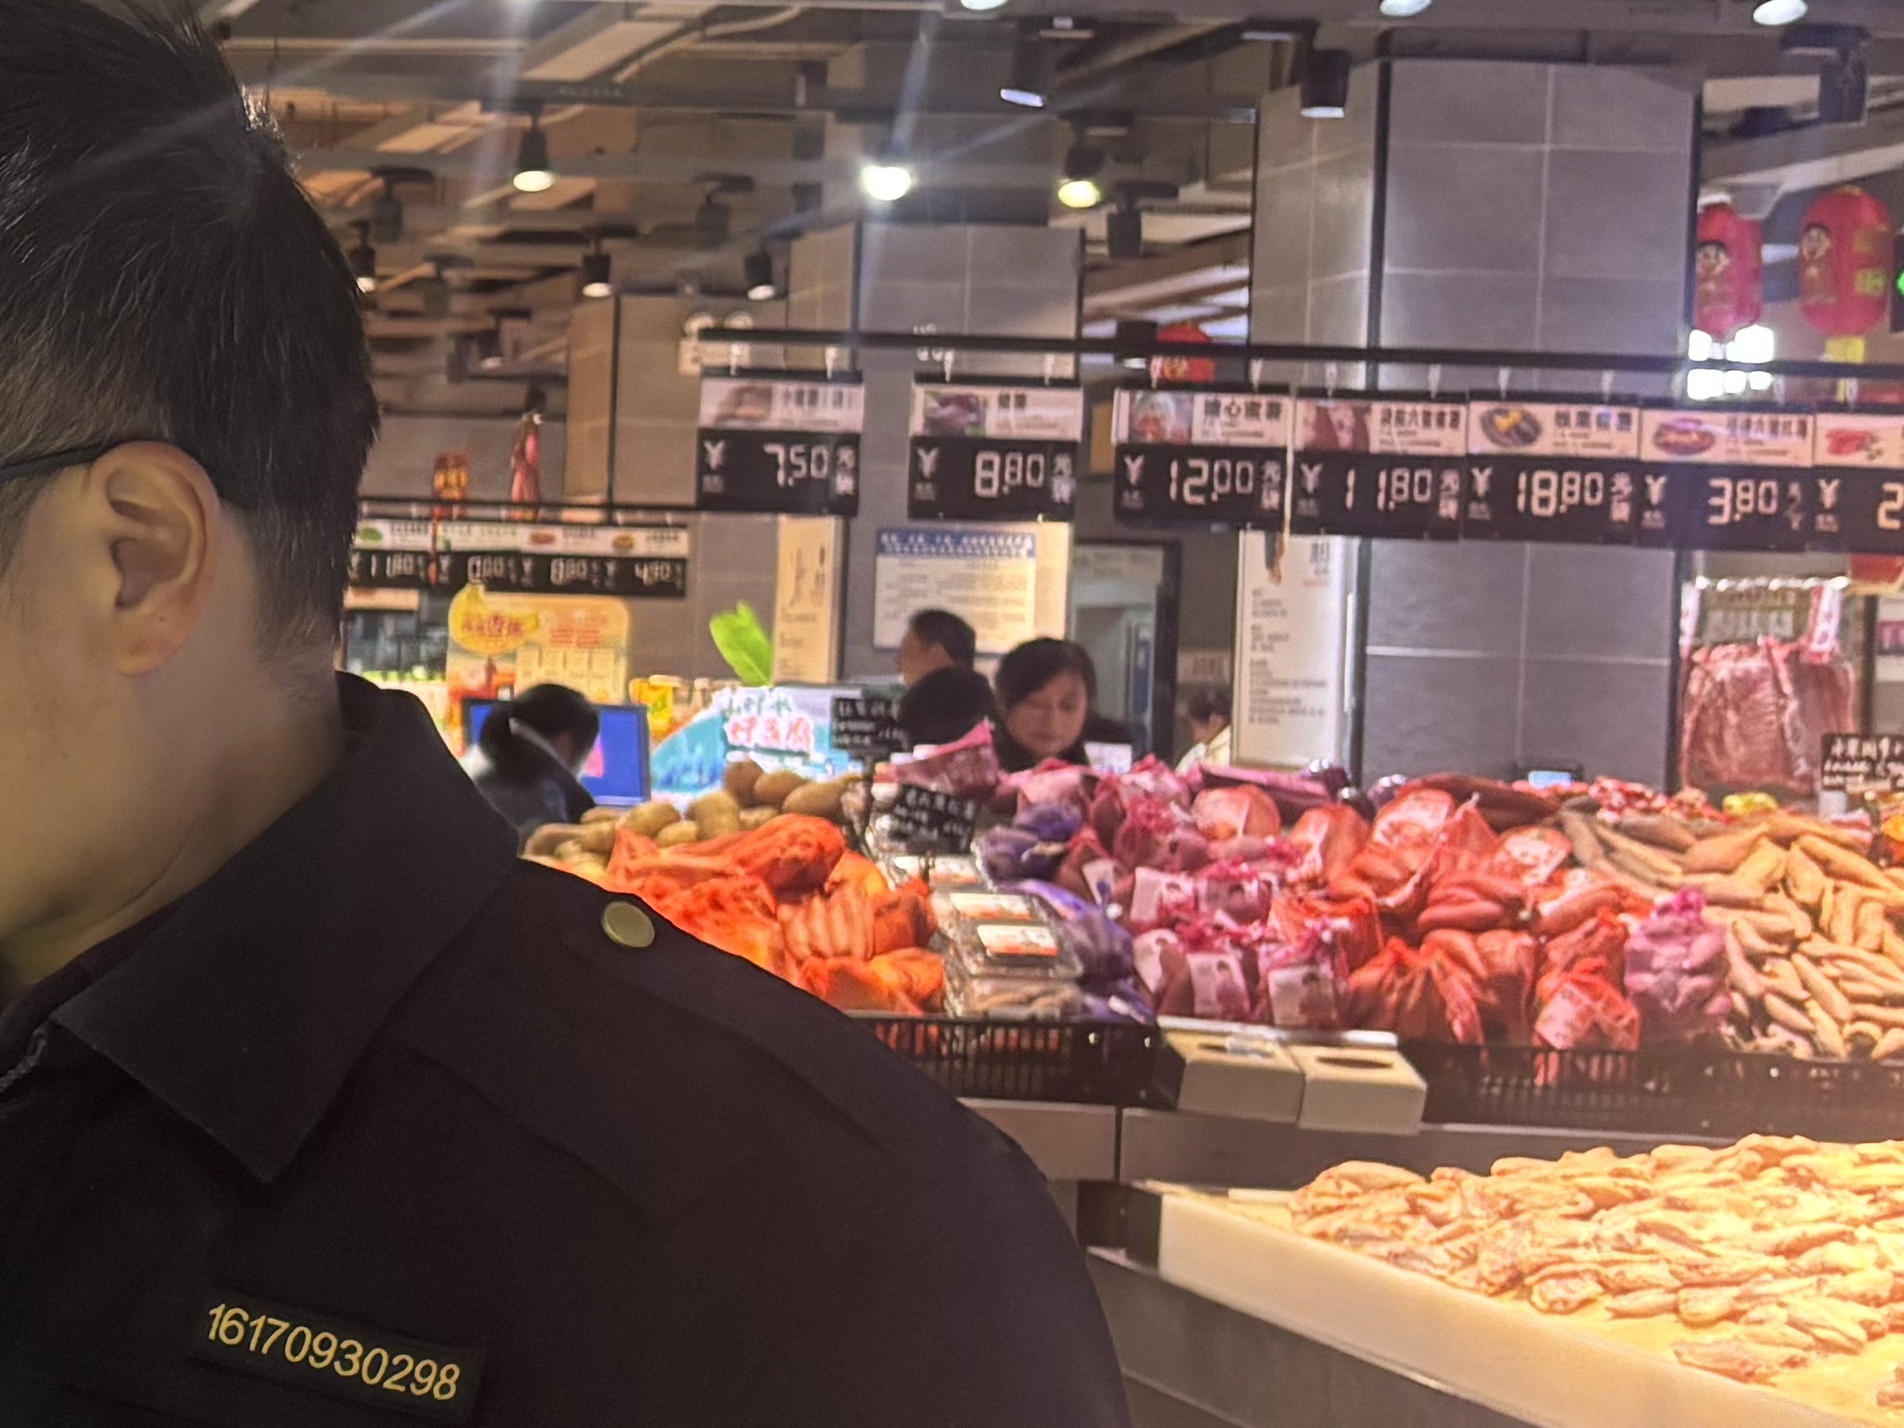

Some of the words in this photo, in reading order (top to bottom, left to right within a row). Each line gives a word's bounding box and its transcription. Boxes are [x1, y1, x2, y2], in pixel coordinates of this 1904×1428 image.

[763, 443, 829, 488] 7.50
[974, 450, 1045, 499] 8.80
[1169, 458, 1254, 505] 12.00
[1517, 470, 1604, 518] 18.80
[1707, 477, 1778, 526] 3.80
[207, 1302, 462, 1401] 16170930298
